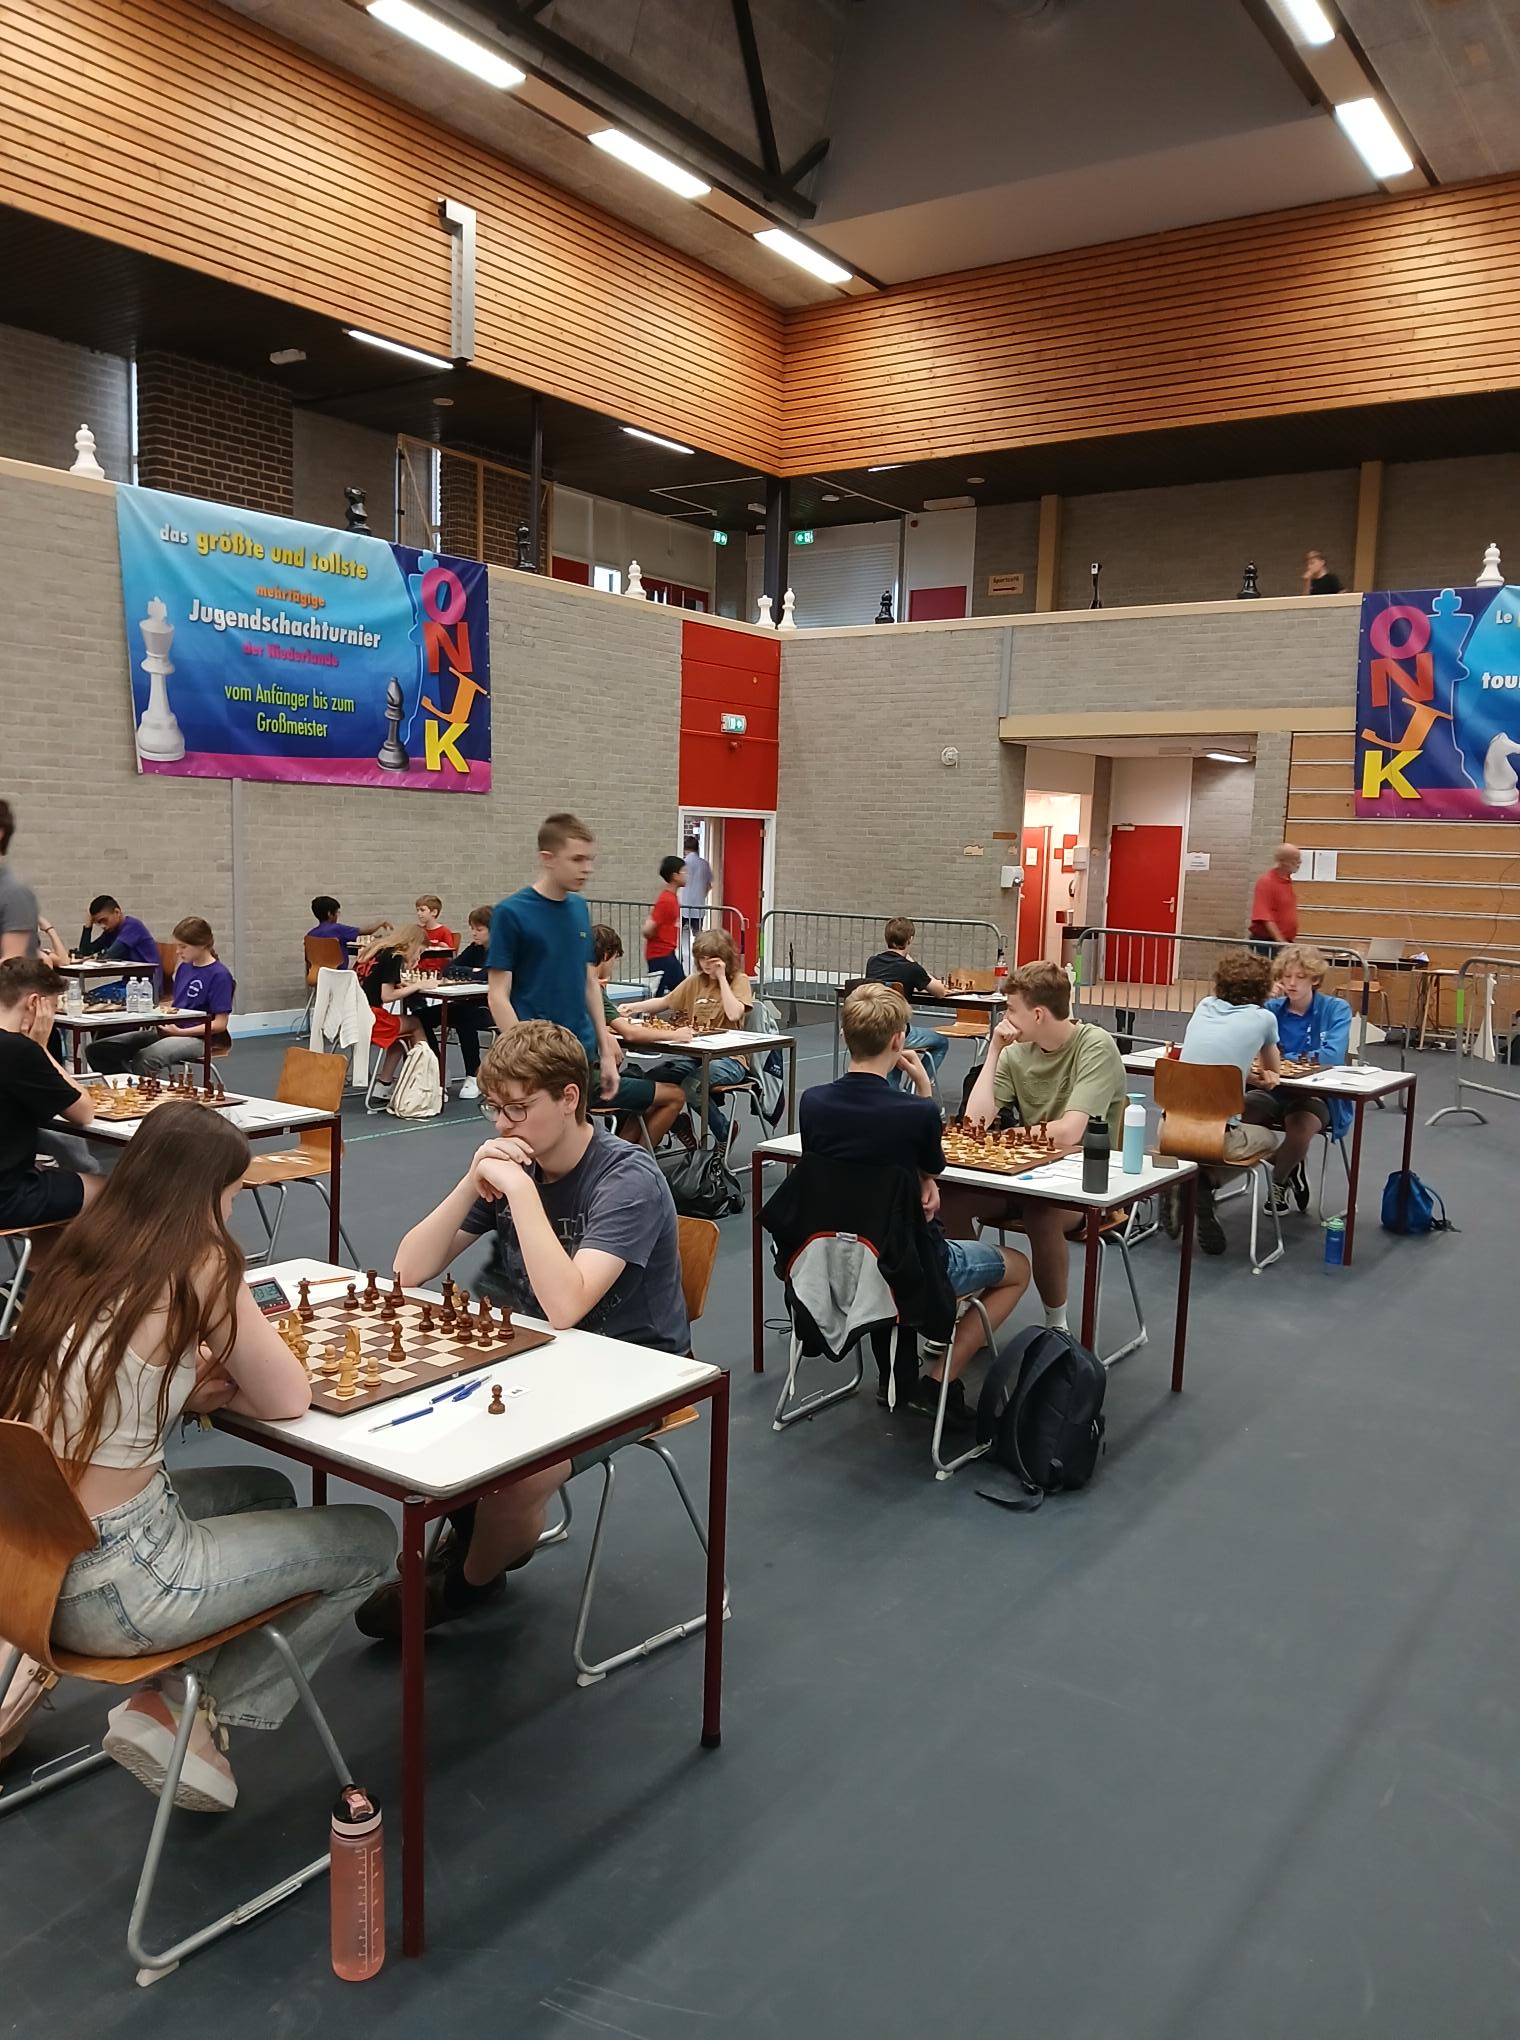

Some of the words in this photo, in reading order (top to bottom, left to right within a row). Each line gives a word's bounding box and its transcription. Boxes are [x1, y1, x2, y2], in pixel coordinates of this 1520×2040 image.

[160, 524, 188, 544] das
[196, 531, 265, 559] größte
[271, 547, 305, 568] und
[311, 552, 368, 579] tollste
[189, 599, 381, 648] Jugendschachturnier
[1495, 610, 1513, 624] Le
[1482, 672, 1520, 689] tou
[225, 685, 252, 702] vom
[256, 683, 309, 711] Anfänger
[313, 688, 328, 710] bis
[331, 696, 355, 713] zum
[256, 712, 328, 737] Großmeister
